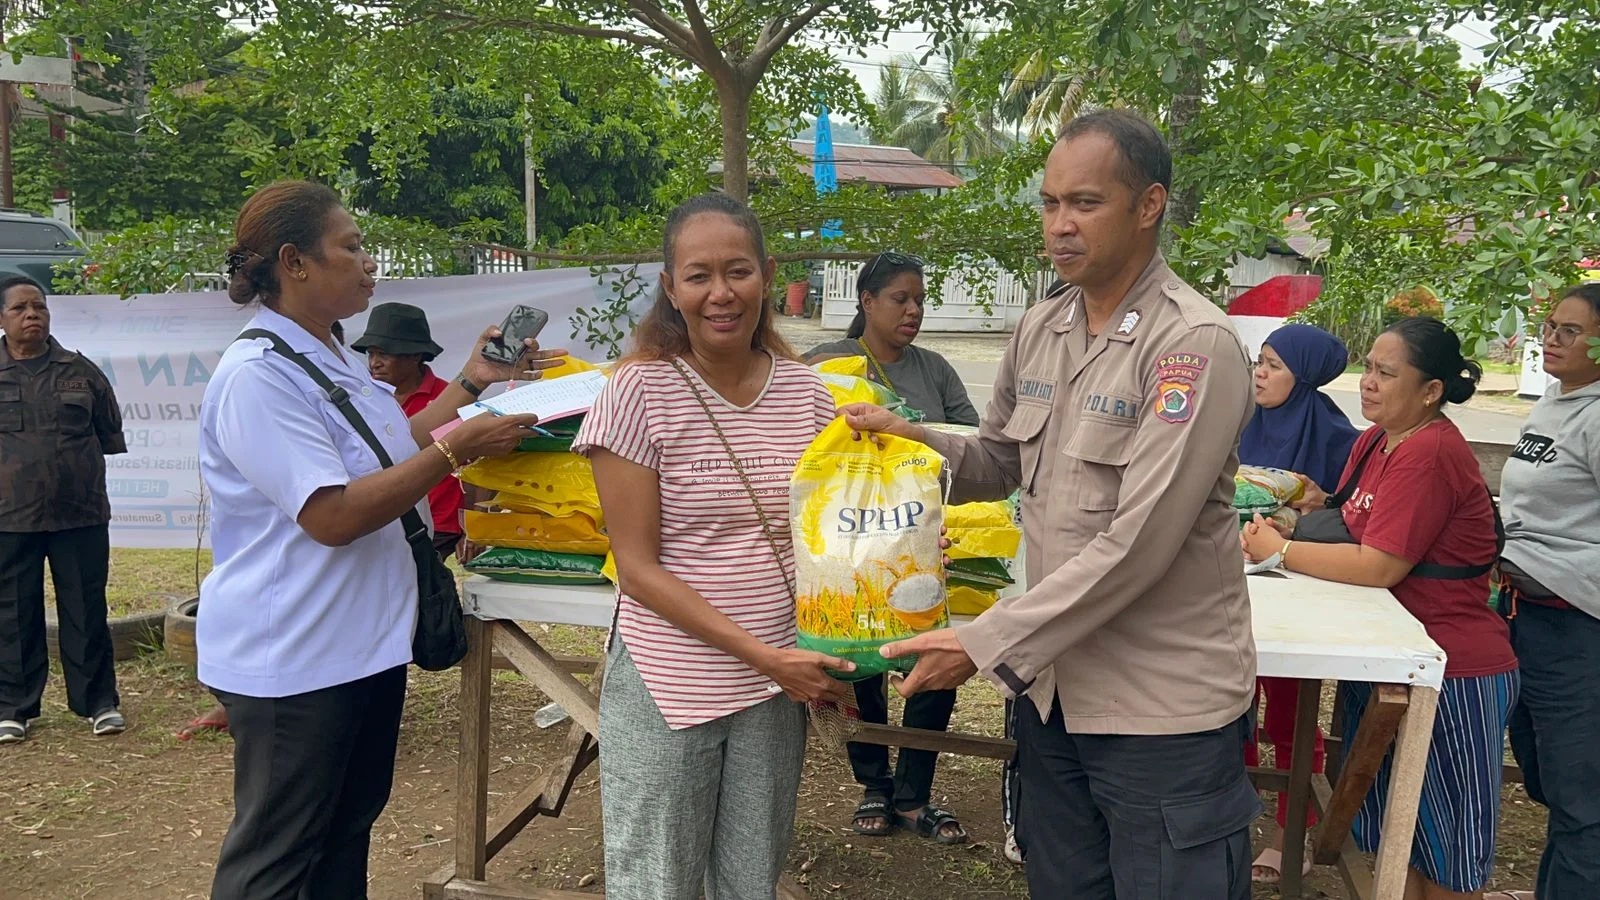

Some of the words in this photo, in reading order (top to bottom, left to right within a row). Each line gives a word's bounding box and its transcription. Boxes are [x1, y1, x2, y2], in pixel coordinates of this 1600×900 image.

[1160, 355, 1199, 368] POLDA
[1084, 394, 1137, 418] POLRI
[838, 500, 924, 533] SPHP
[860, 802, 885, 810] adidas
